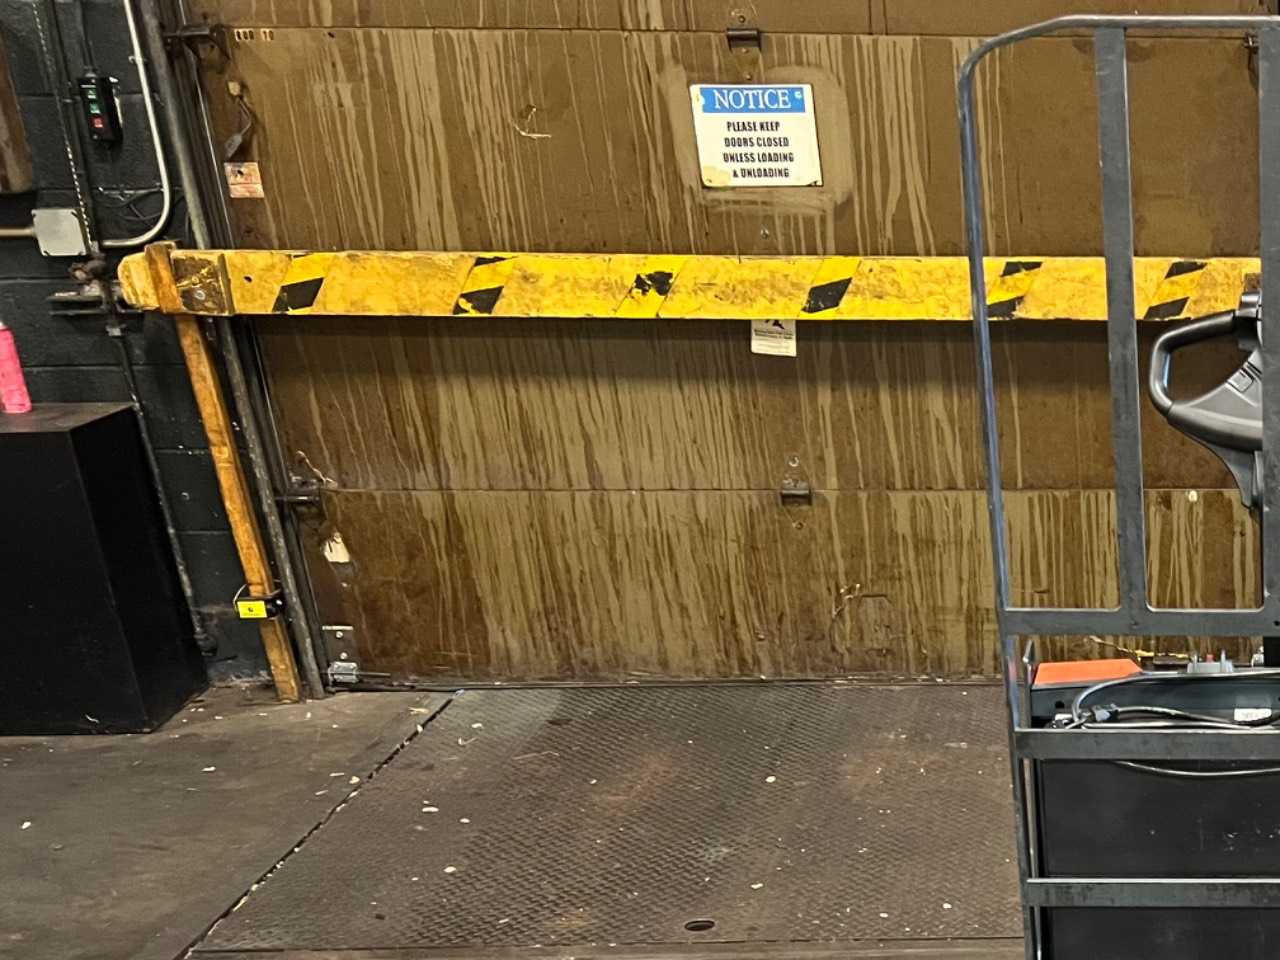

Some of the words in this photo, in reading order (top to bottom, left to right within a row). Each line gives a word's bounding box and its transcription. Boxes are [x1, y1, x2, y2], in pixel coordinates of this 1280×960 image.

[713, 89, 792, 109] NOTICE
[726, 121, 757, 132] PLEASE
[759, 121, 780, 132] KEEP
[724, 137, 755, 147] DOORS
[756, 137, 790, 147] CLOSED
[722, 152, 755, 163] UNLESS
[757, 152, 794, 163] LOADING
[740, 168, 790, 178] UNLOADING
